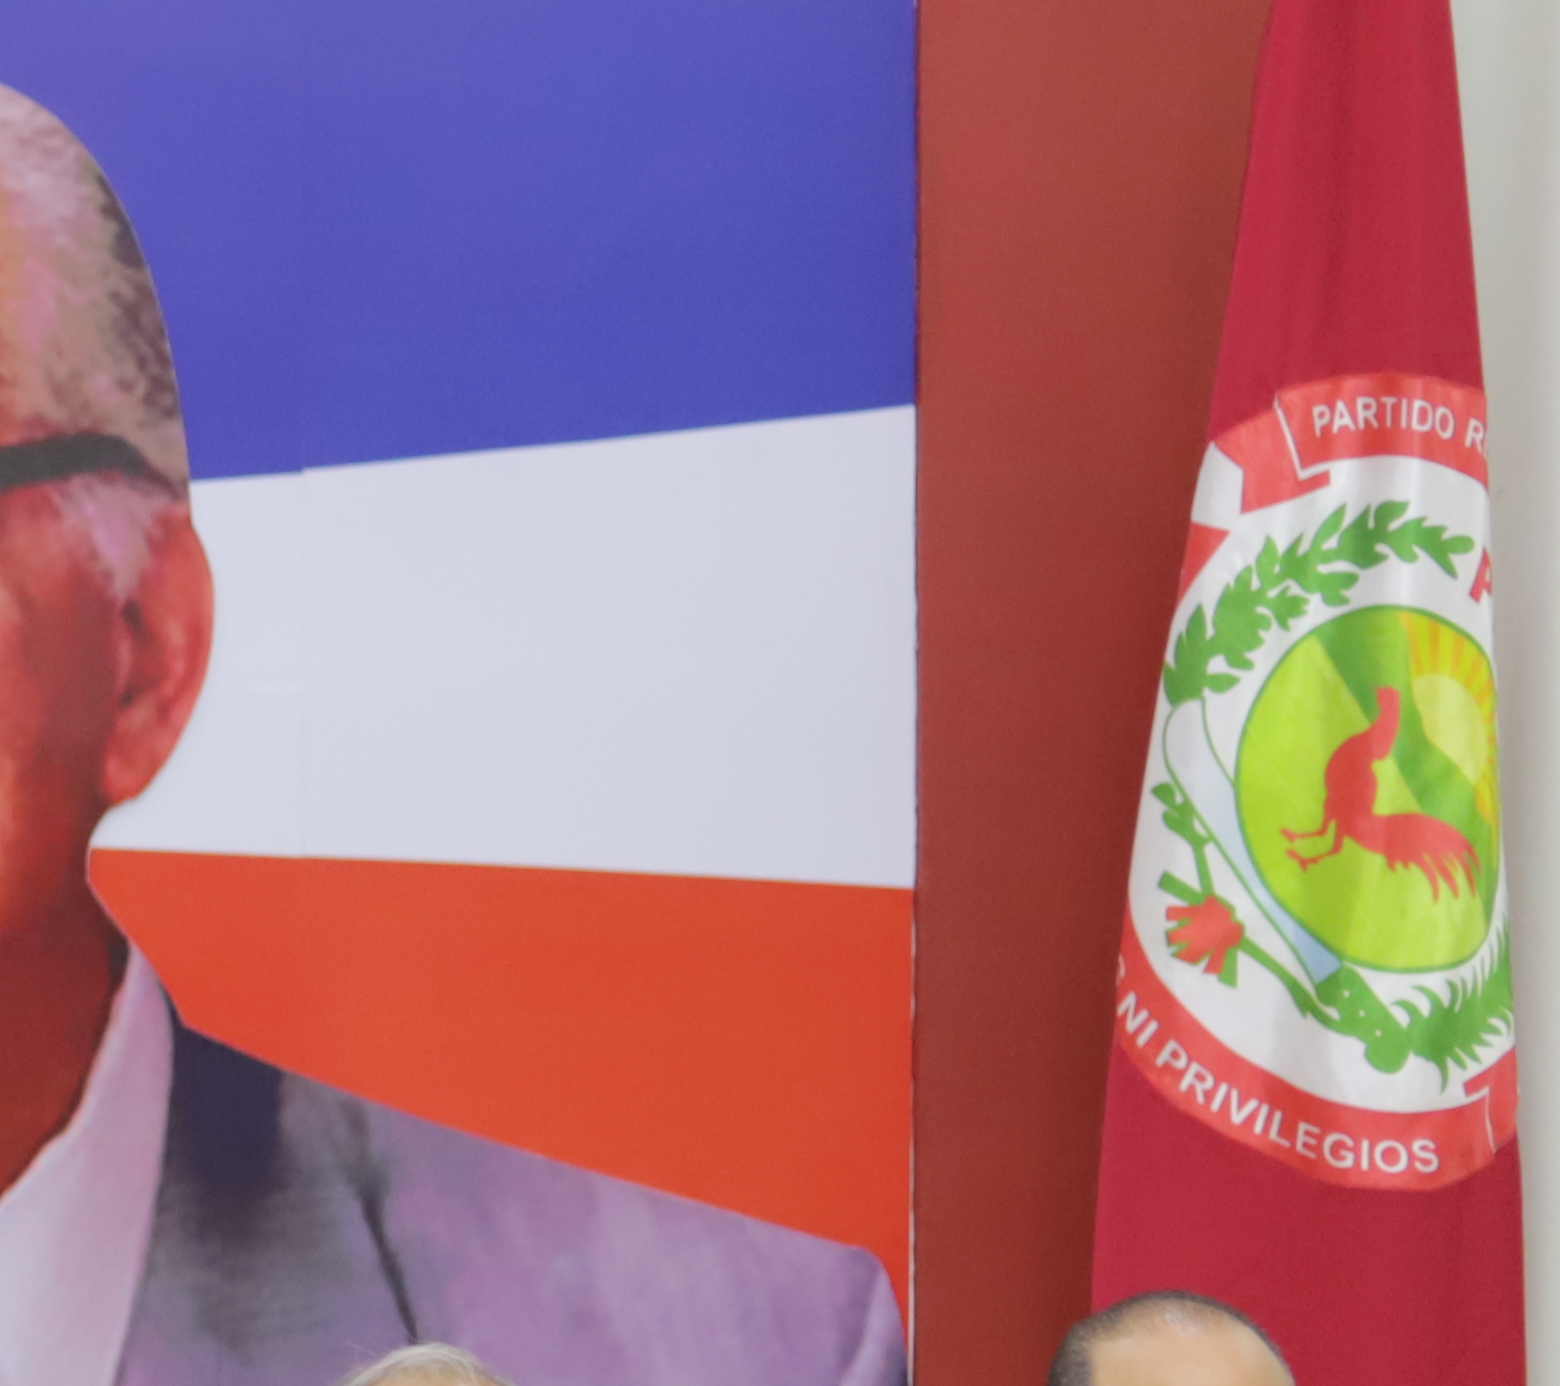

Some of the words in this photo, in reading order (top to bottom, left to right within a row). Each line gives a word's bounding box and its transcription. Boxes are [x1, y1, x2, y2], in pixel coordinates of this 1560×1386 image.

[1313, 396, 1455, 441] PARTIDO
[1117, 991, 1159, 1048] NI
[1154, 1038, 1441, 1175] PRIVILEGIOS
